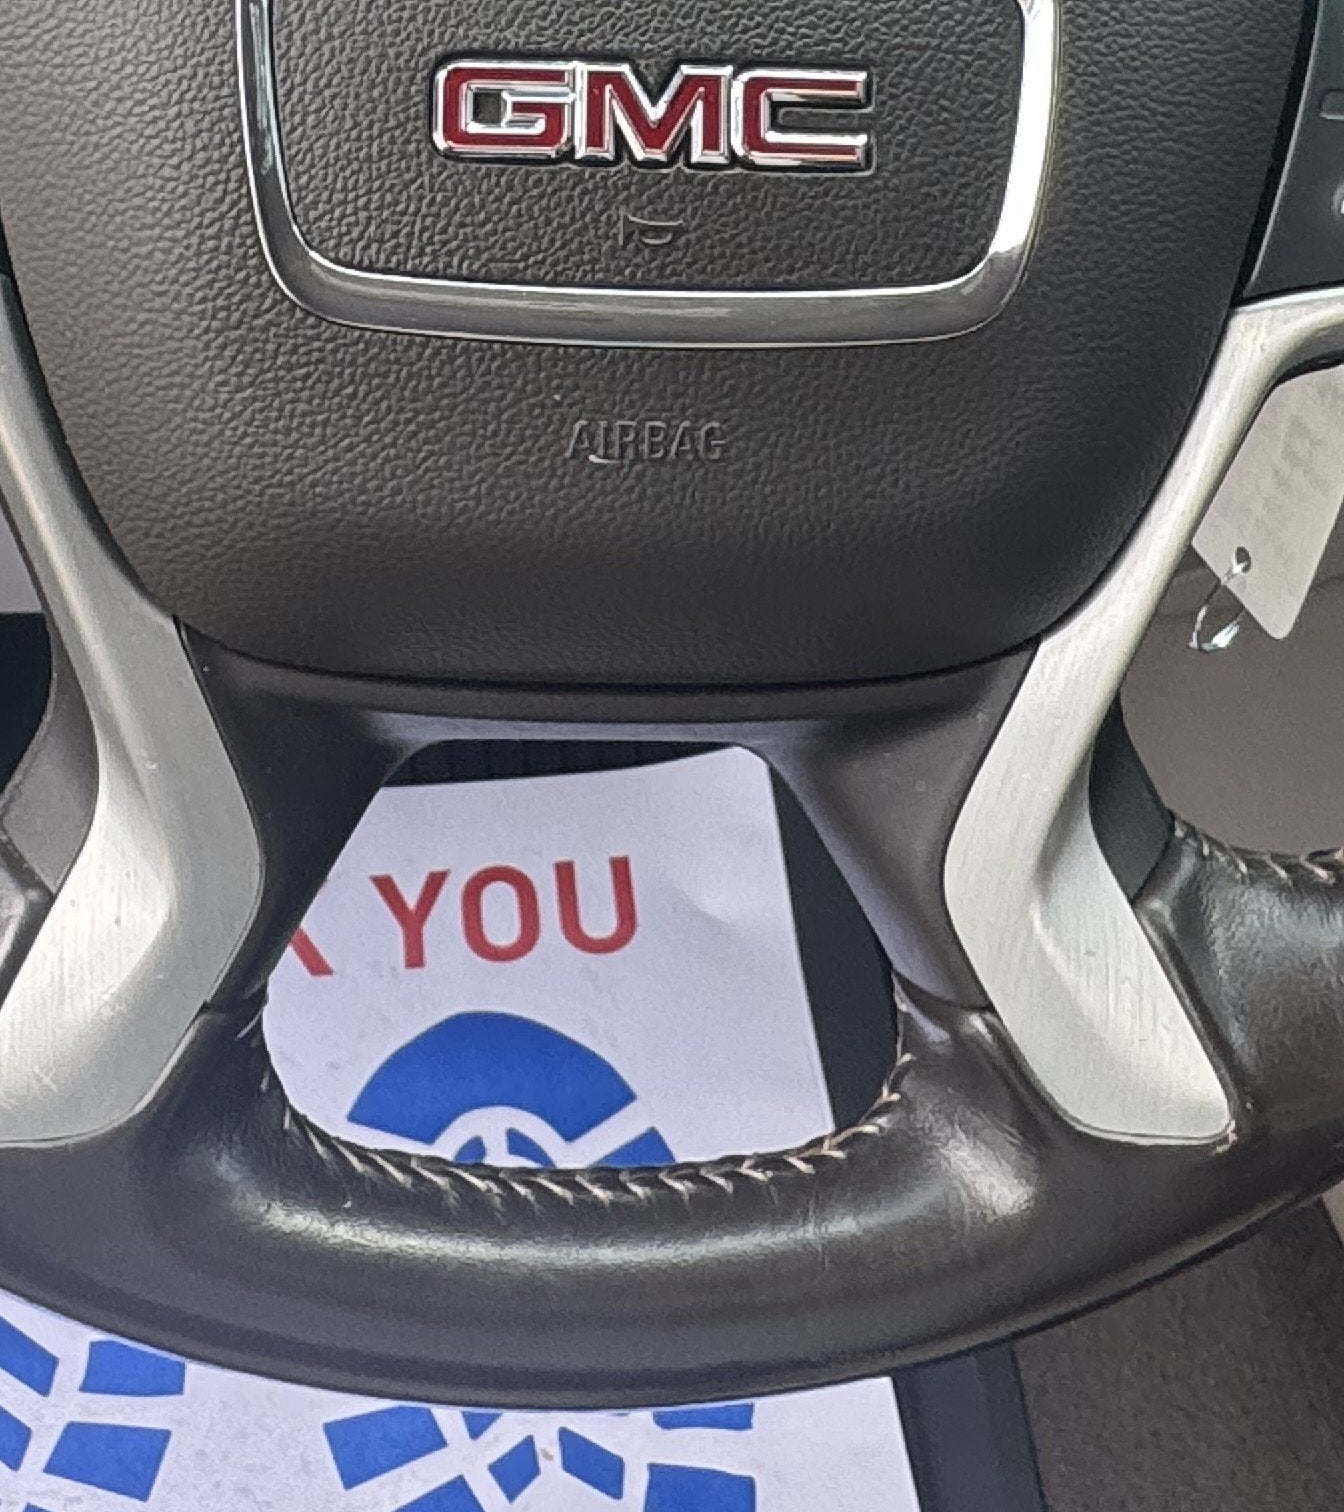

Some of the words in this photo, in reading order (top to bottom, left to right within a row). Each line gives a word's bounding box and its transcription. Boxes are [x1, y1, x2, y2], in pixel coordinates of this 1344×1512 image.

[434, 60, 869, 168] GMC
[566, 420, 728, 462] AIRBAG
[369, 854, 639, 970] YOU
